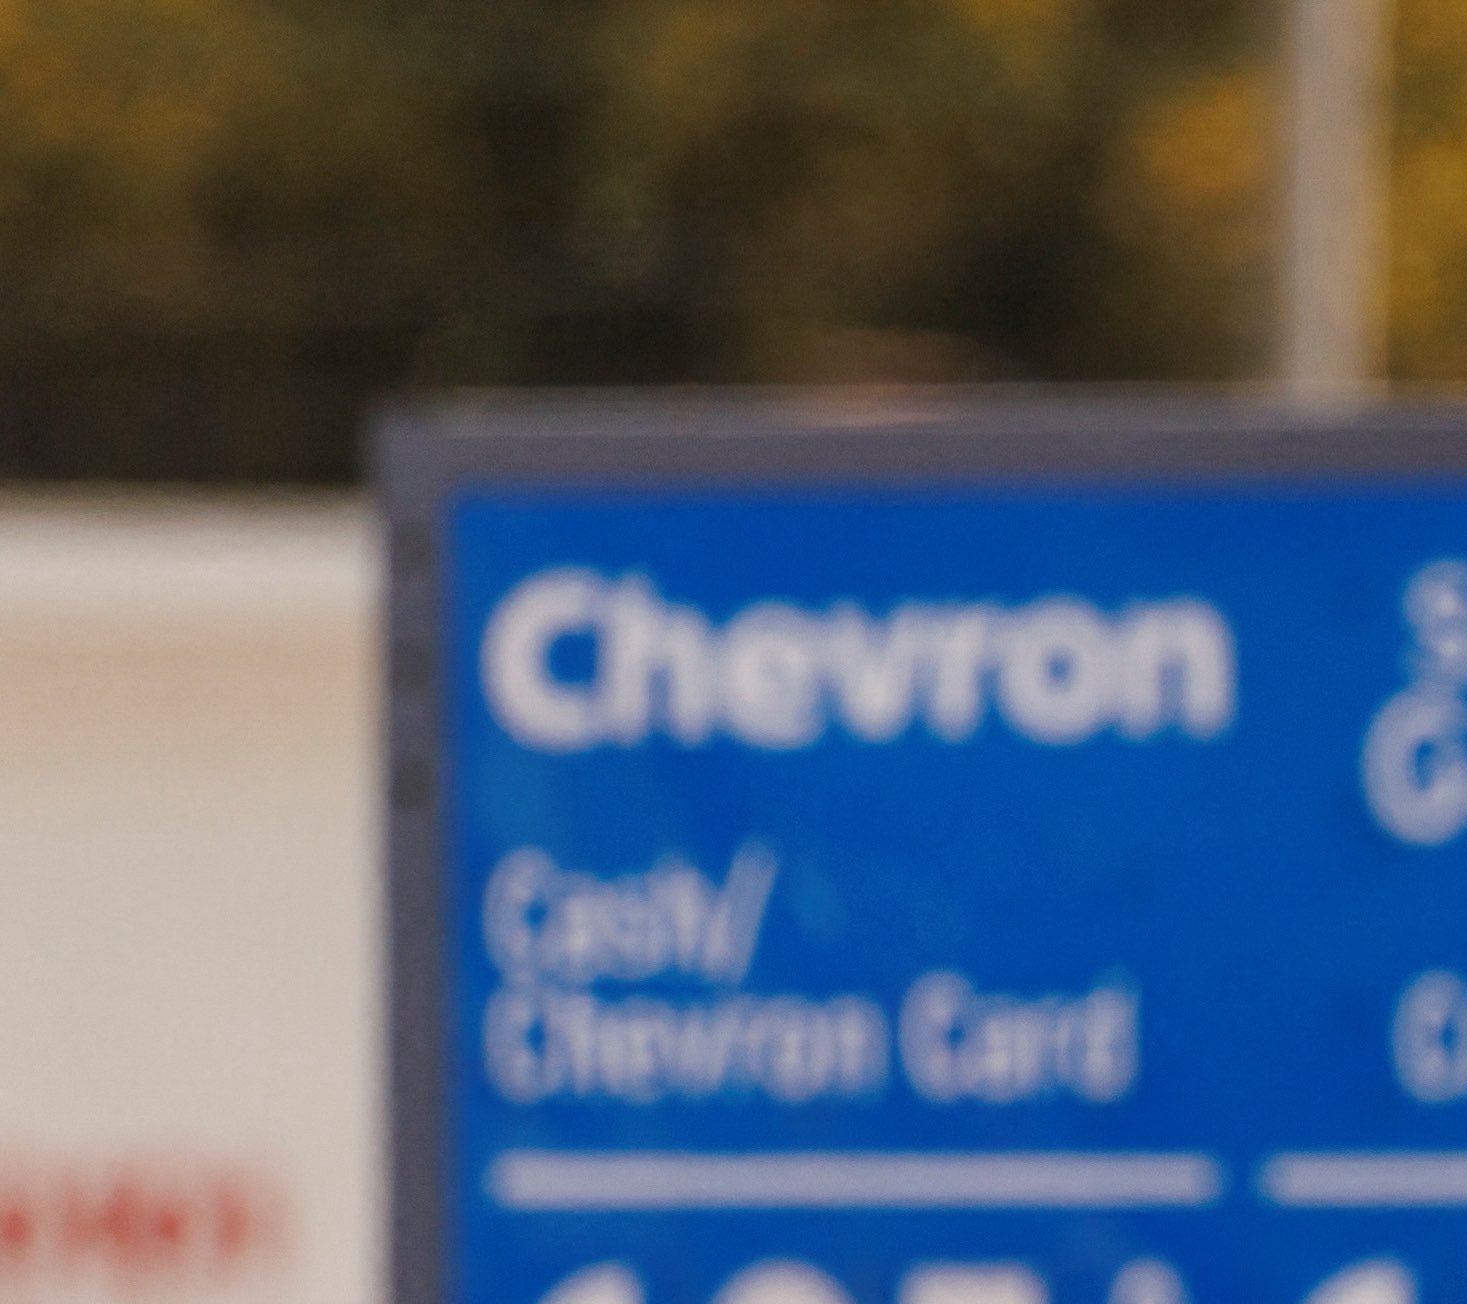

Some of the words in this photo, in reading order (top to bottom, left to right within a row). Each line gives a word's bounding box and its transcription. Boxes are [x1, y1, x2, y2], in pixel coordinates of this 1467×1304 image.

[482, 571, 1232, 747] Chevron
[485, 848, 773, 982] Cash/
[485, 973, 888, 1100] Chevron
[900, 973, 1136, 1100] Card
